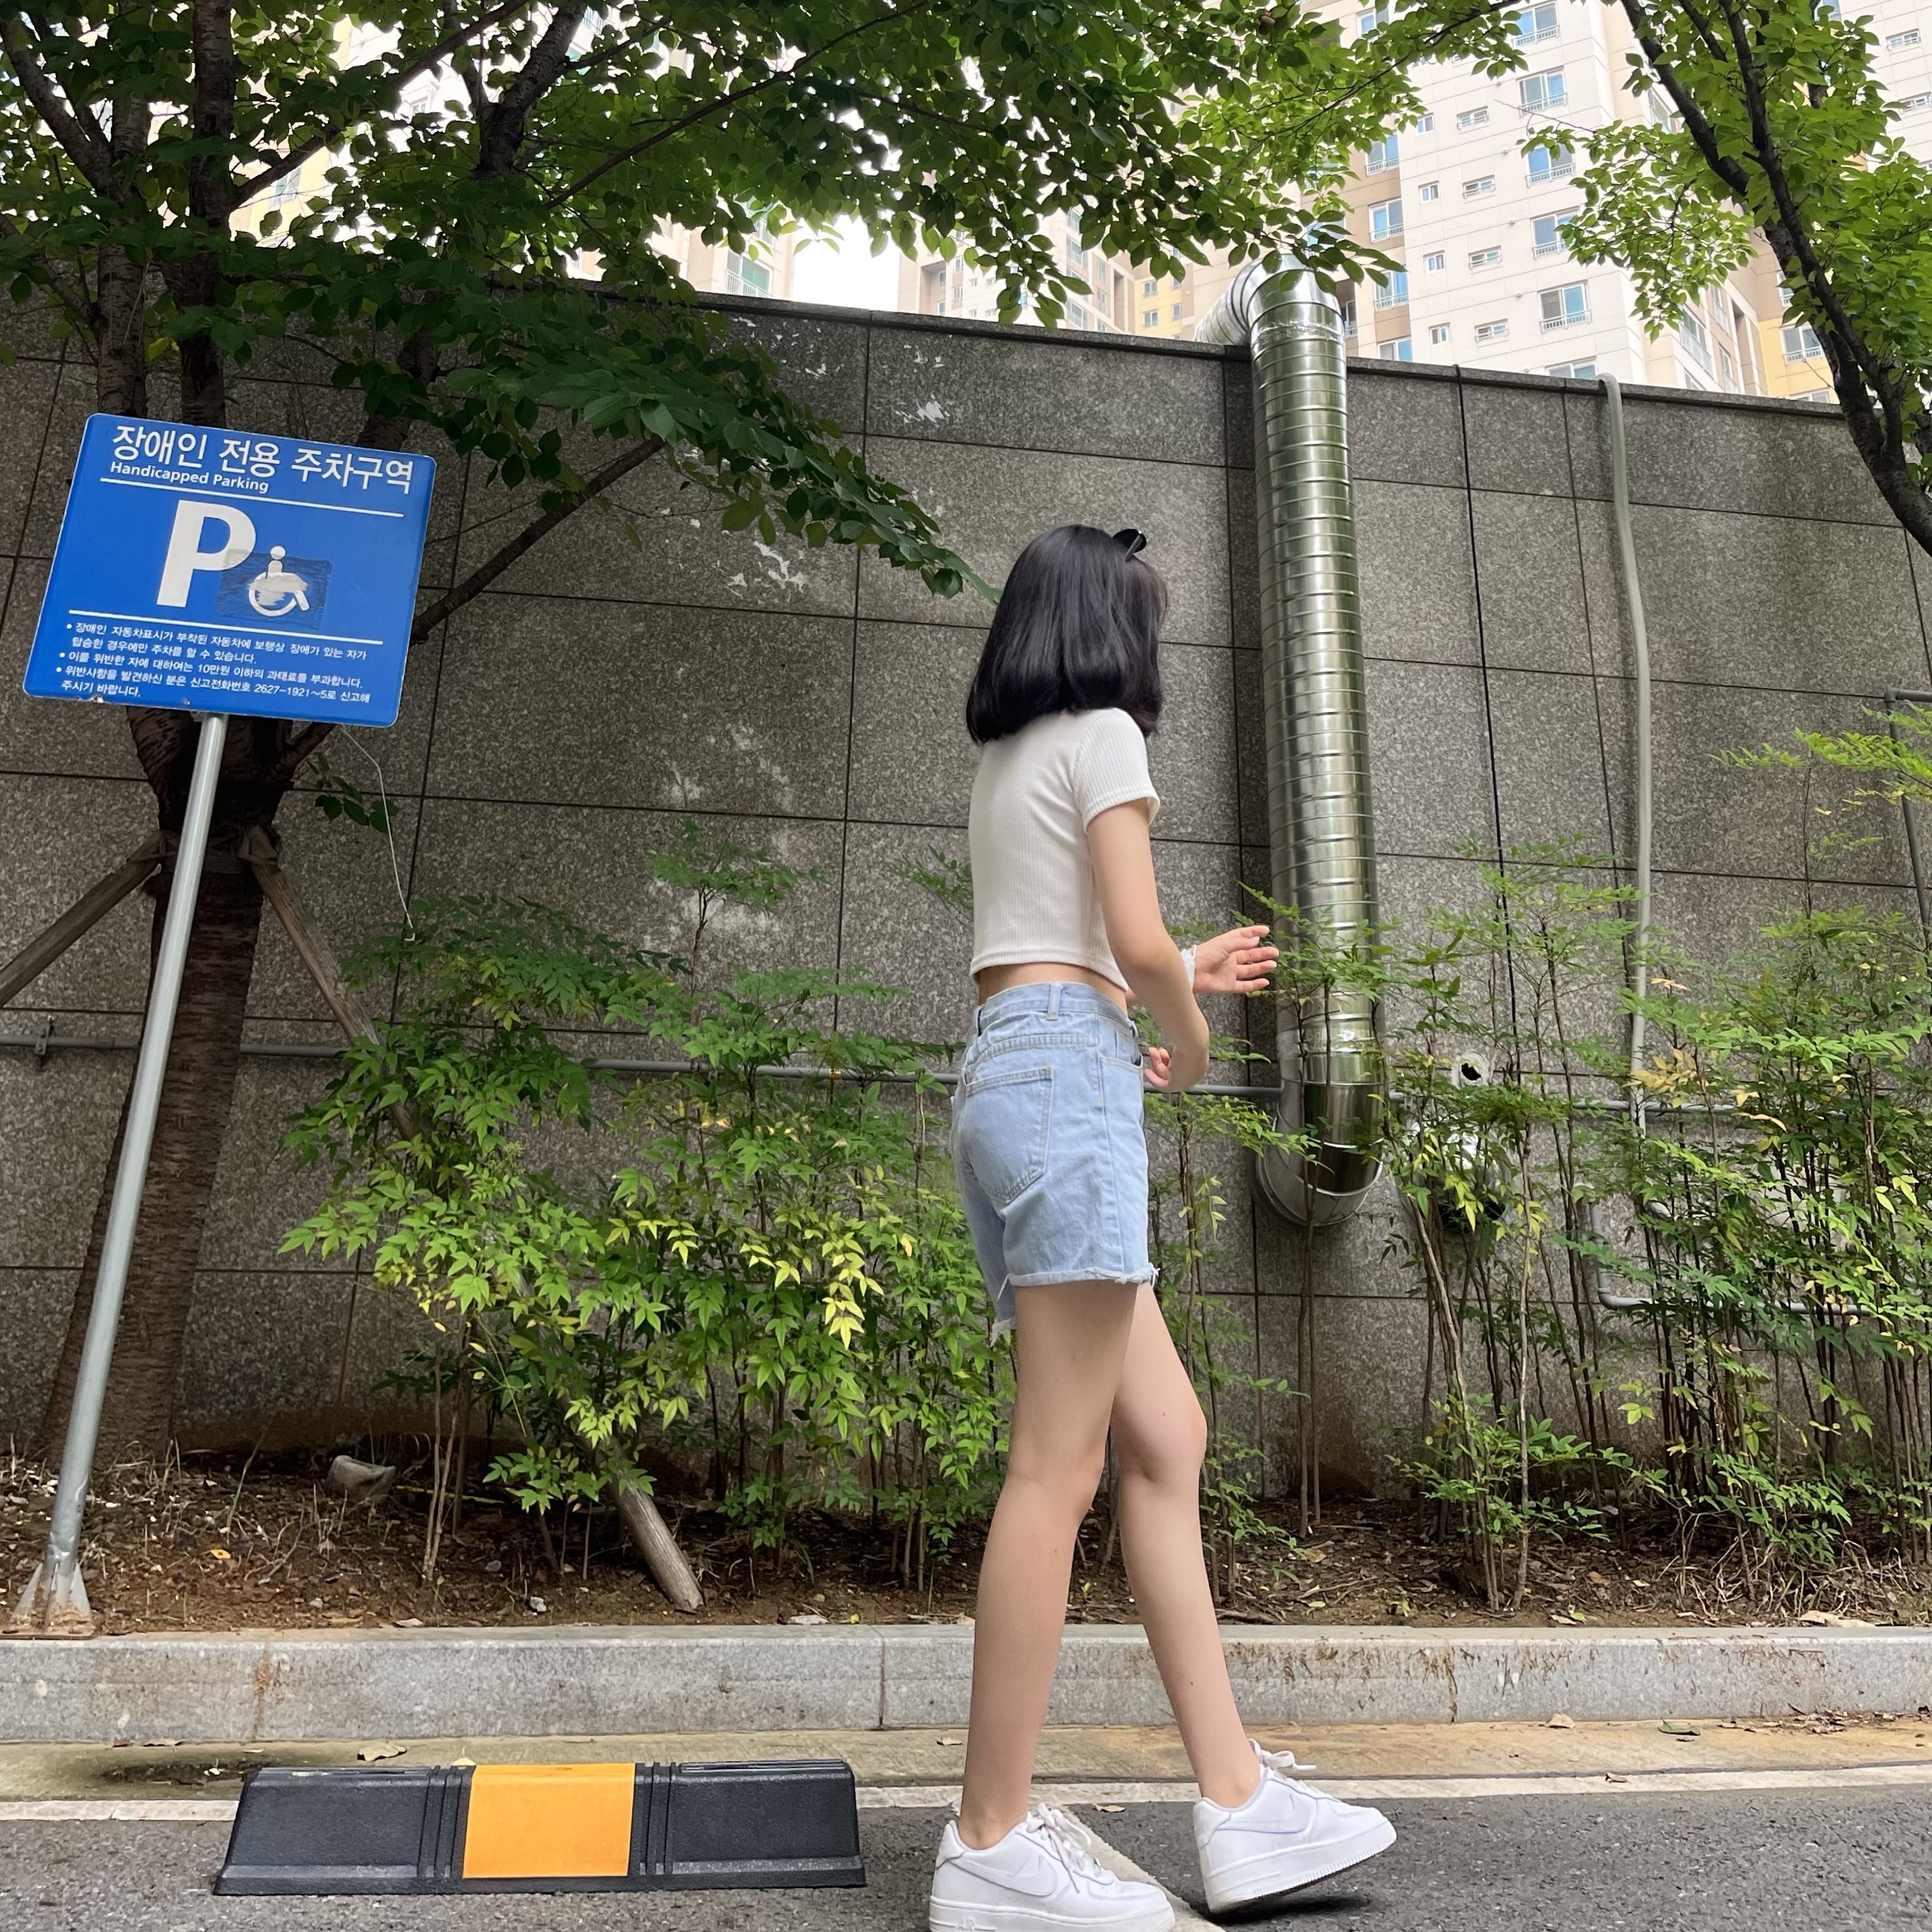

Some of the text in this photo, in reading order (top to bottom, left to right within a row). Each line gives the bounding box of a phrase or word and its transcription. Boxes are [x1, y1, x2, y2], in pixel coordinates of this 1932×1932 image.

[111, 461, 269, 494] Handicapped Parking
[113, 425, 413, 495] 장애인 전용 주차구역
[157, 500, 256, 607] P
[72, 636, 257, 663] 탑승한 경우에만 주차를 할 수 있습니다.
[76, 623, 366, 661] 장애인 자동차표시가 부착된 자동차에 보행상 장애가 있는 자가
[65, 665, 117, 680] 위반사항을
[121, 670, 163, 684] 발견하신
[166, 675, 186, 686] 분은
[191, 677, 251, 692] 신고전화번호
[340, 691, 371, 703] 신고해
[69, 651, 363, 688] 이를 위반한 자에 대하여는 10만원 이하의 과태료를 부과합니다.
[62, 680, 141, 697] 주시기 바랍니다.
